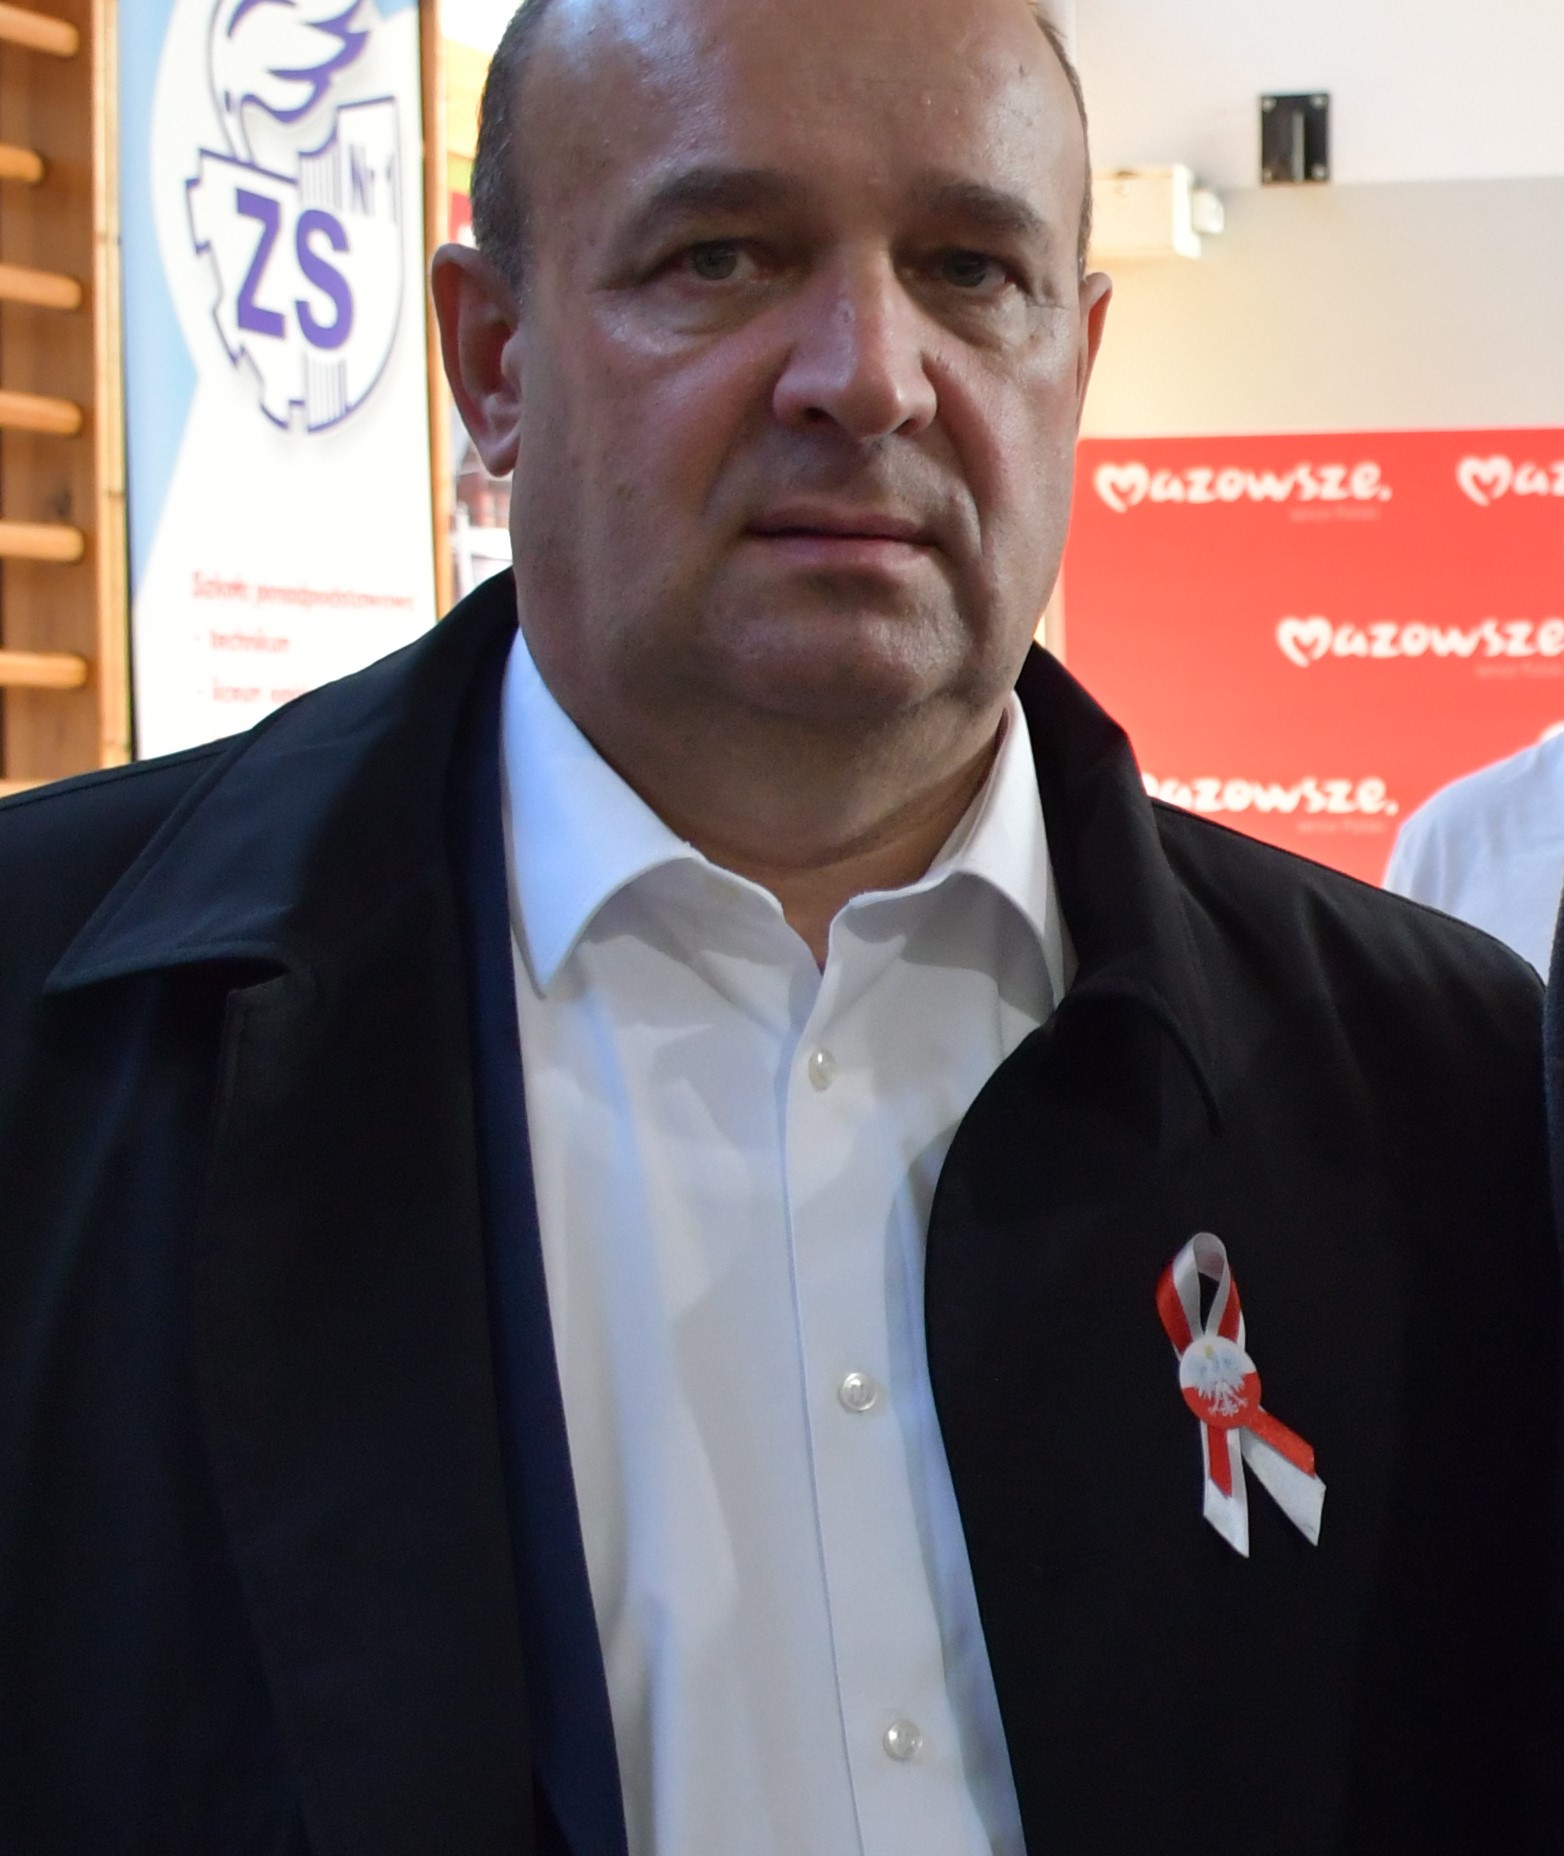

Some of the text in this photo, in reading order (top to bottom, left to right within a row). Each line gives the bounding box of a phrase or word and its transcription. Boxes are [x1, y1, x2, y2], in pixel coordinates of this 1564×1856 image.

[235, 186, 354, 351] ZS
[1094, 460, 1393, 514] Mazowsze.
[1142, 772, 1399, 816] azowsze.
